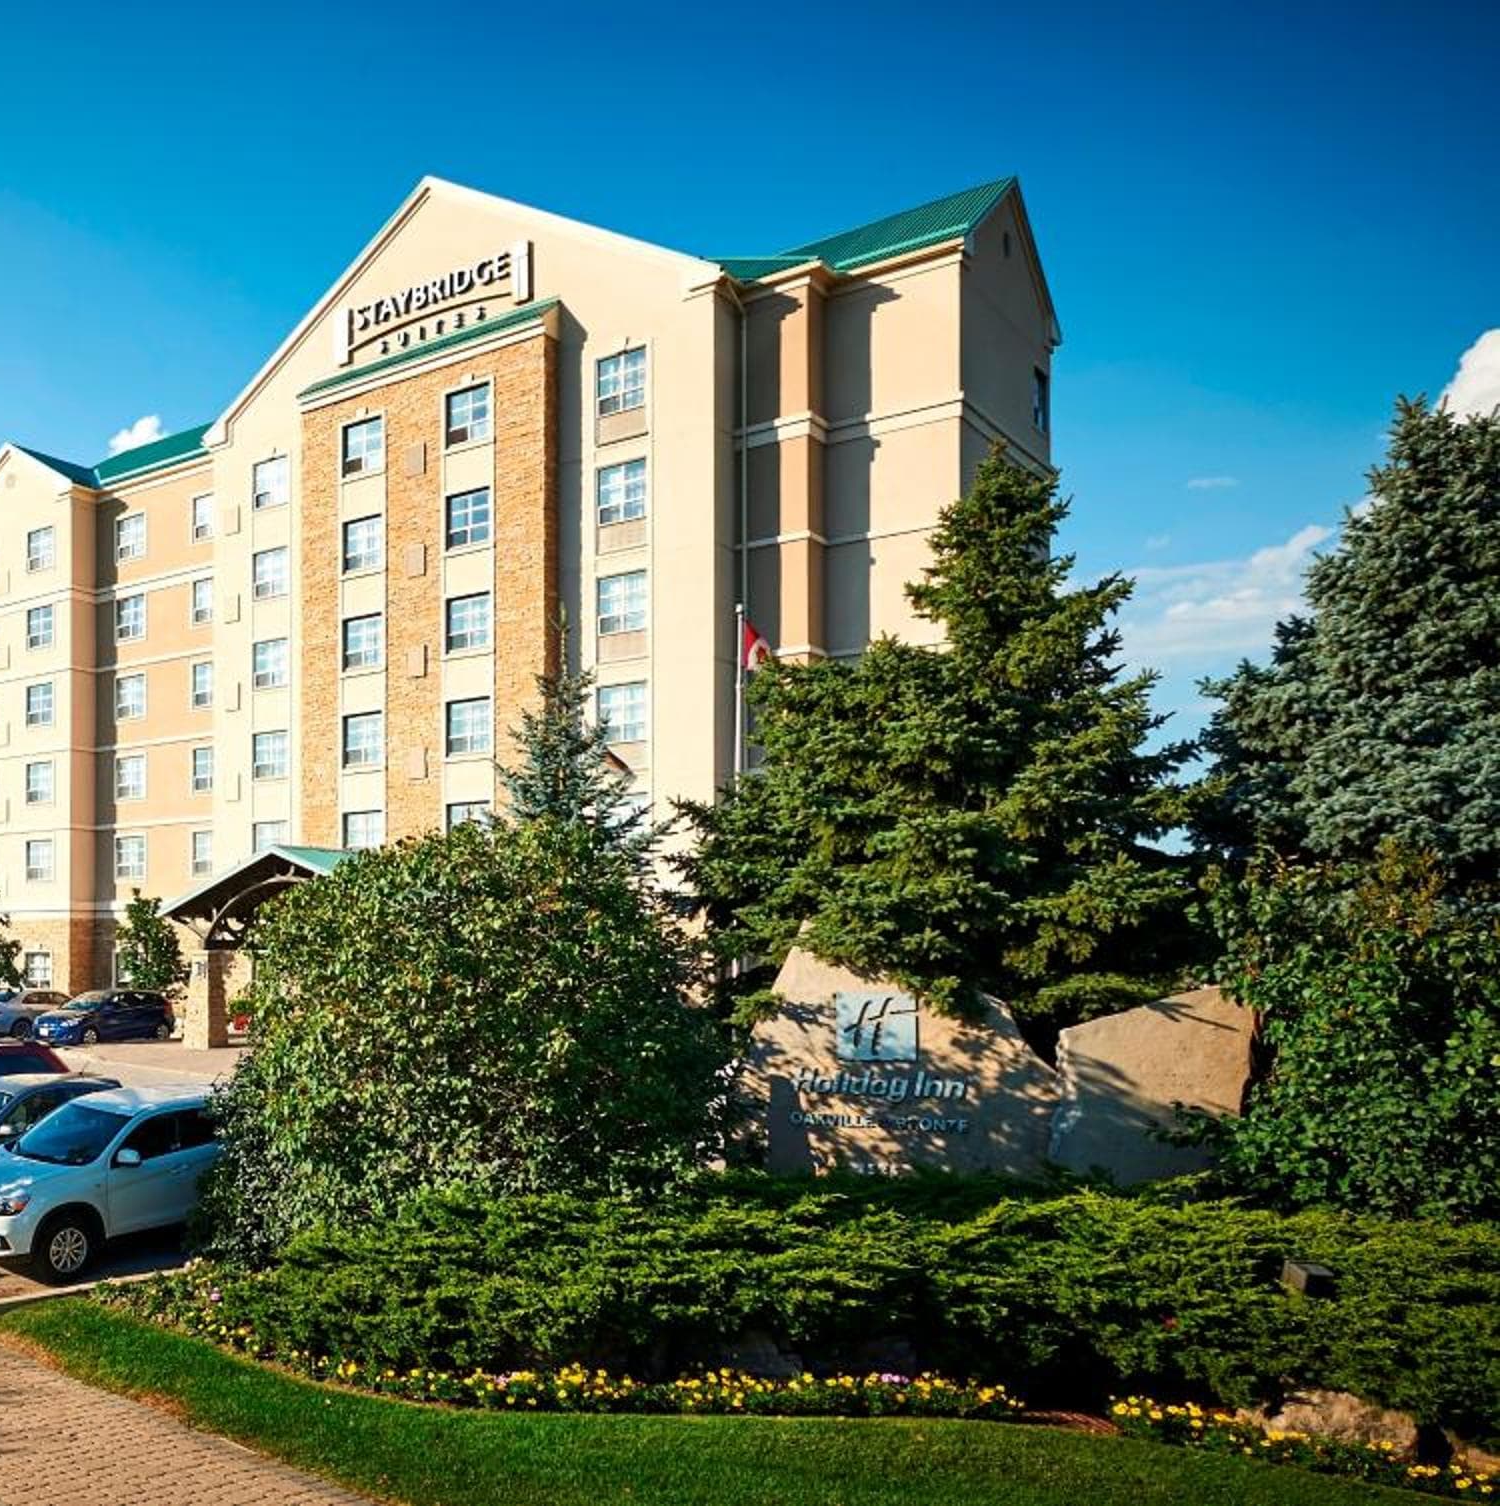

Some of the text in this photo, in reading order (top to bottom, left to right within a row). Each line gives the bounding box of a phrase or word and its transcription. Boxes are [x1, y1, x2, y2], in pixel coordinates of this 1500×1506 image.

[356, 250, 511, 331] STAYBRIDGE
[379, 304, 486, 355] SUITES
[791, 1068, 965, 1102] Holiday Inn
[790, 1111, 877, 1128] OAKVILLE
